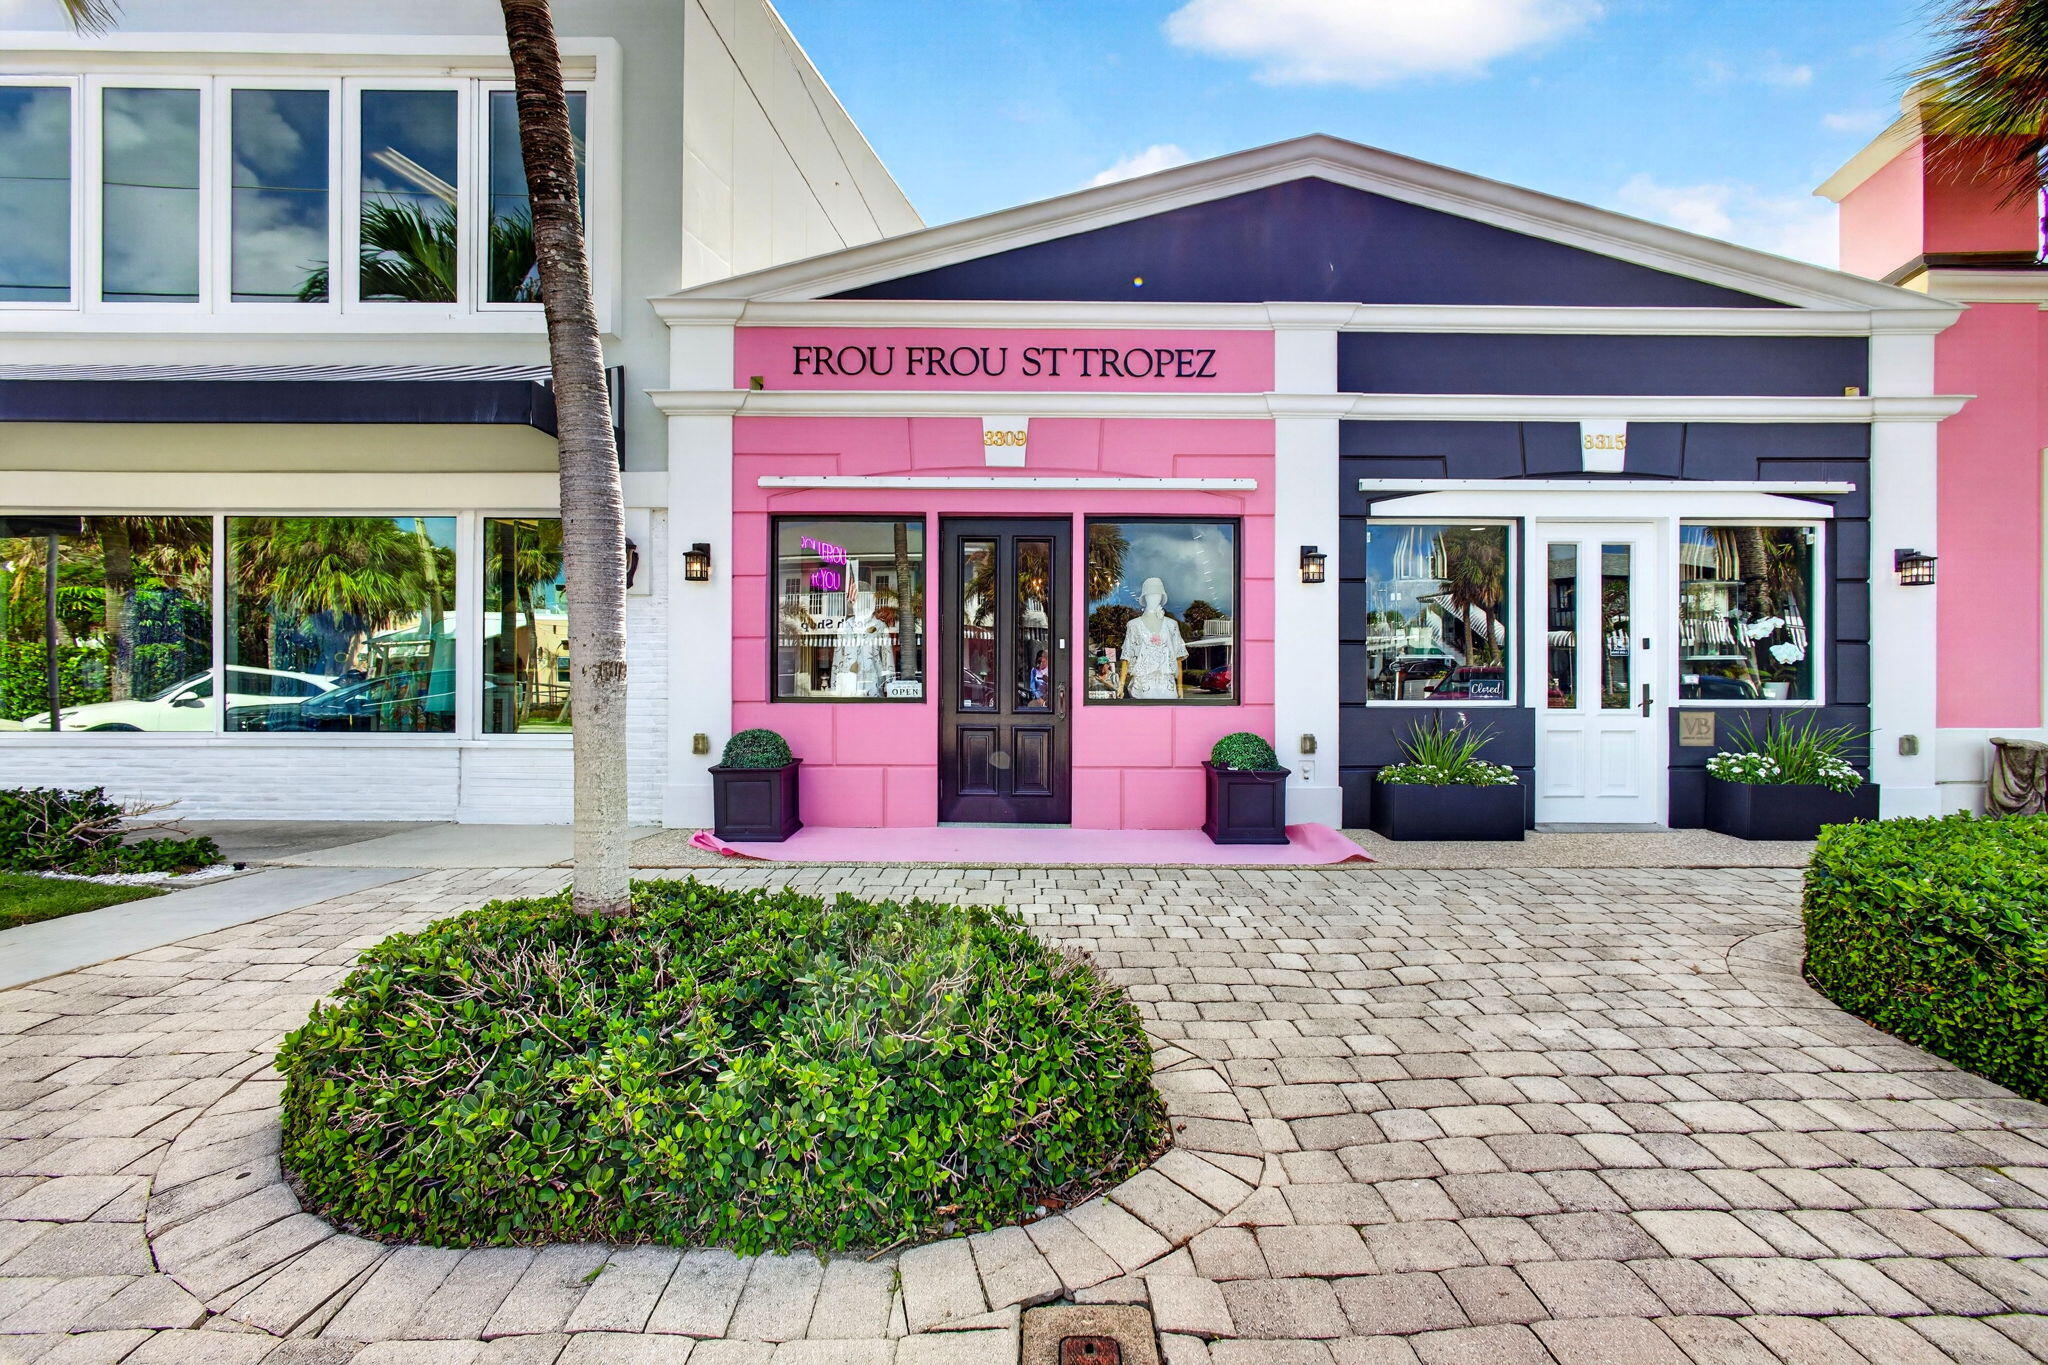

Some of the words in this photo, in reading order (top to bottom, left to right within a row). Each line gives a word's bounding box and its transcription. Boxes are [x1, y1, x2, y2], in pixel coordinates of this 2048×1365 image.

[792, 345, 895, 376] FROU
[905, 346, 1008, 377] FROU
[1022, 346, 1068, 377] ST
[1072, 347, 1218, 378] TROPEZ
[984, 430, 1027, 447] 3309
[1583, 433, 1627, 451] 3315
[891, 688, 919, 696] OPEN
[1471, 682, 1502, 695] Closed
[1683, 717, 1711, 736] VB
